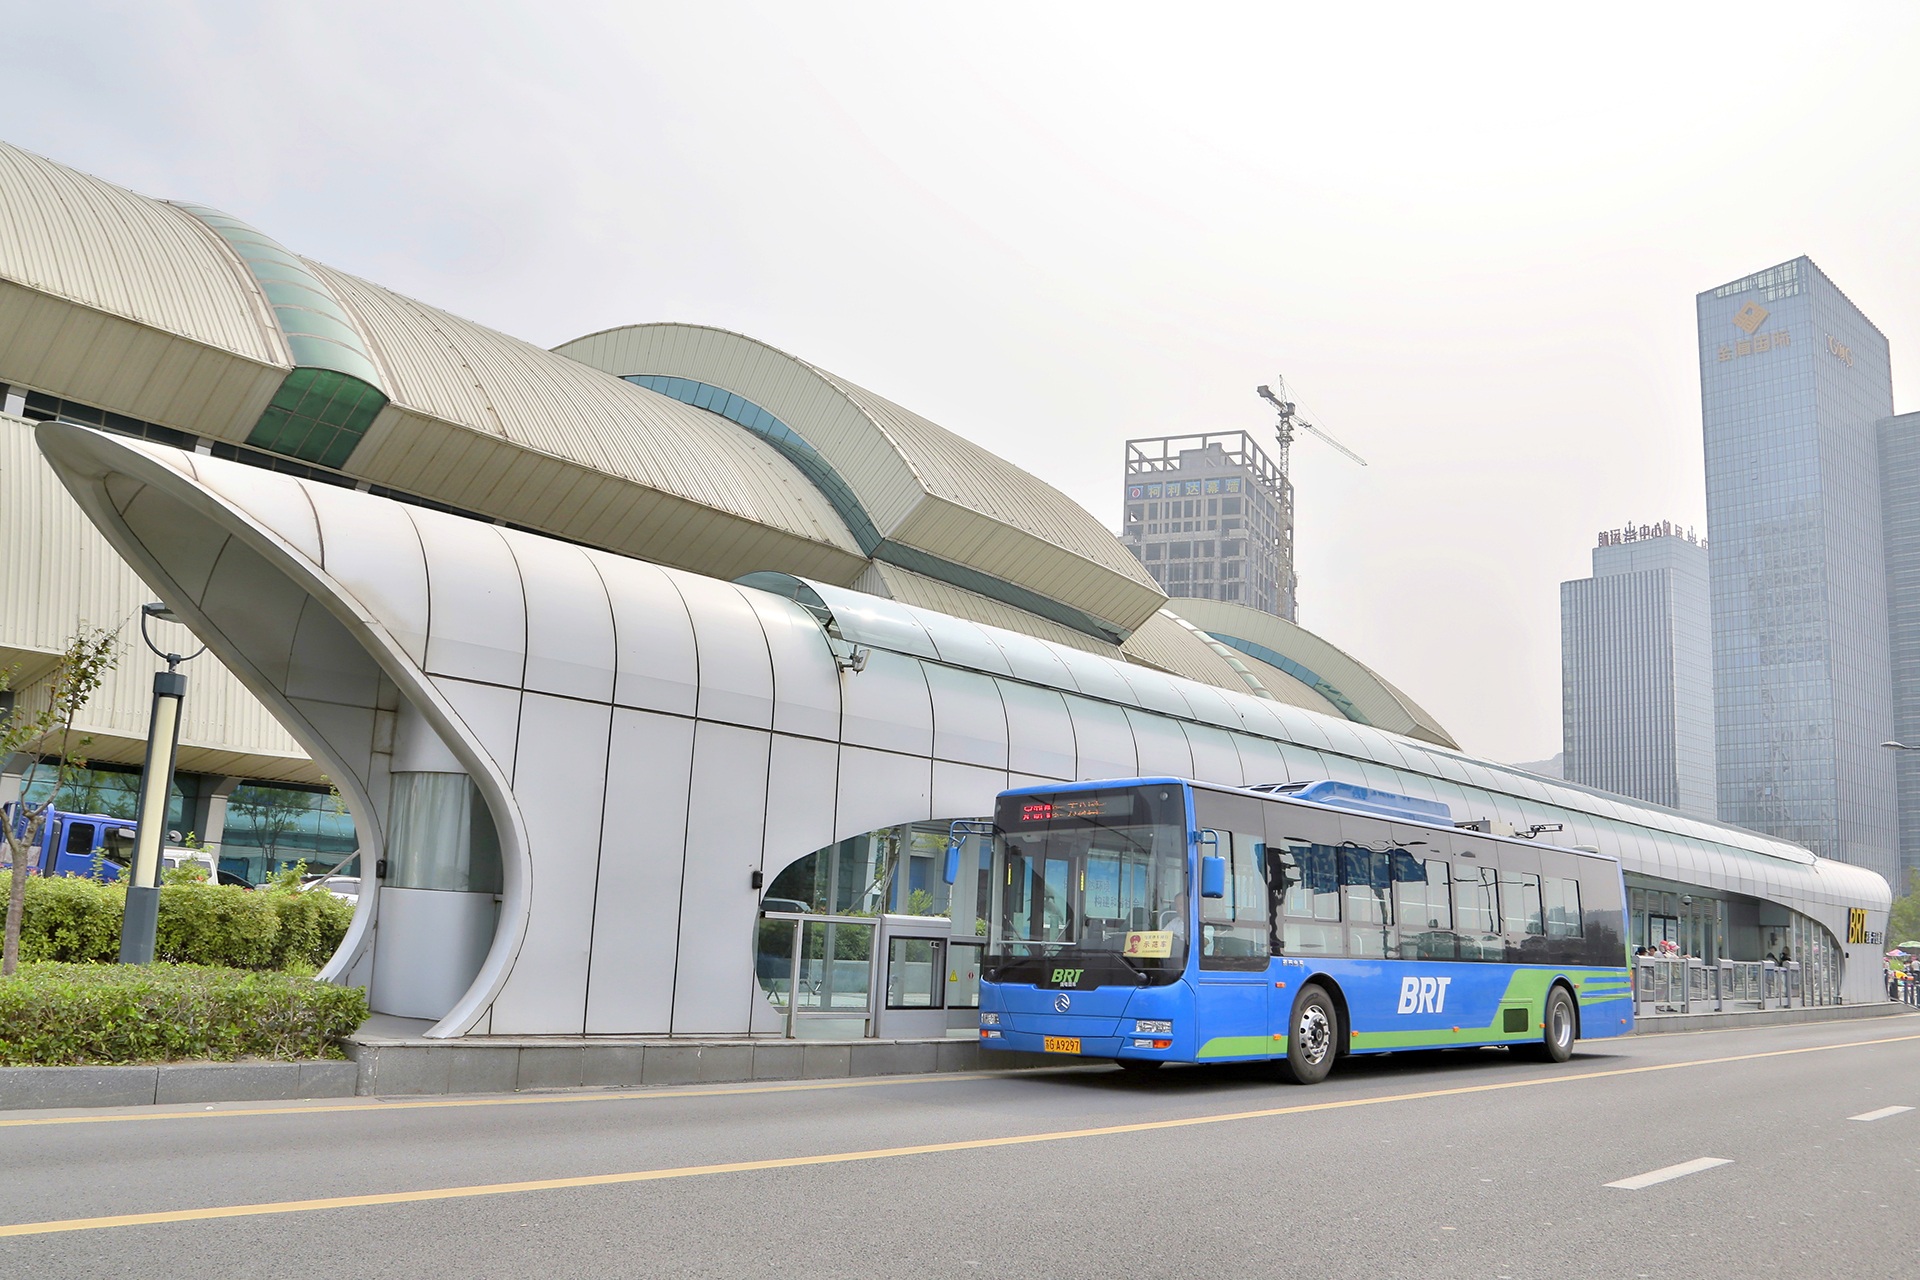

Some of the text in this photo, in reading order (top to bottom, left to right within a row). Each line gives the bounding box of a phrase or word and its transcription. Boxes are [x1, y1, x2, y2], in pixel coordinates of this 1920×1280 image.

[1148, 481, 1239, 498] 柯利达幕墙
[1848, 907, 1868, 944] BRT
[1051, 968, 1084, 983] BRT
[1397, 976, 1452, 1014] BRT
